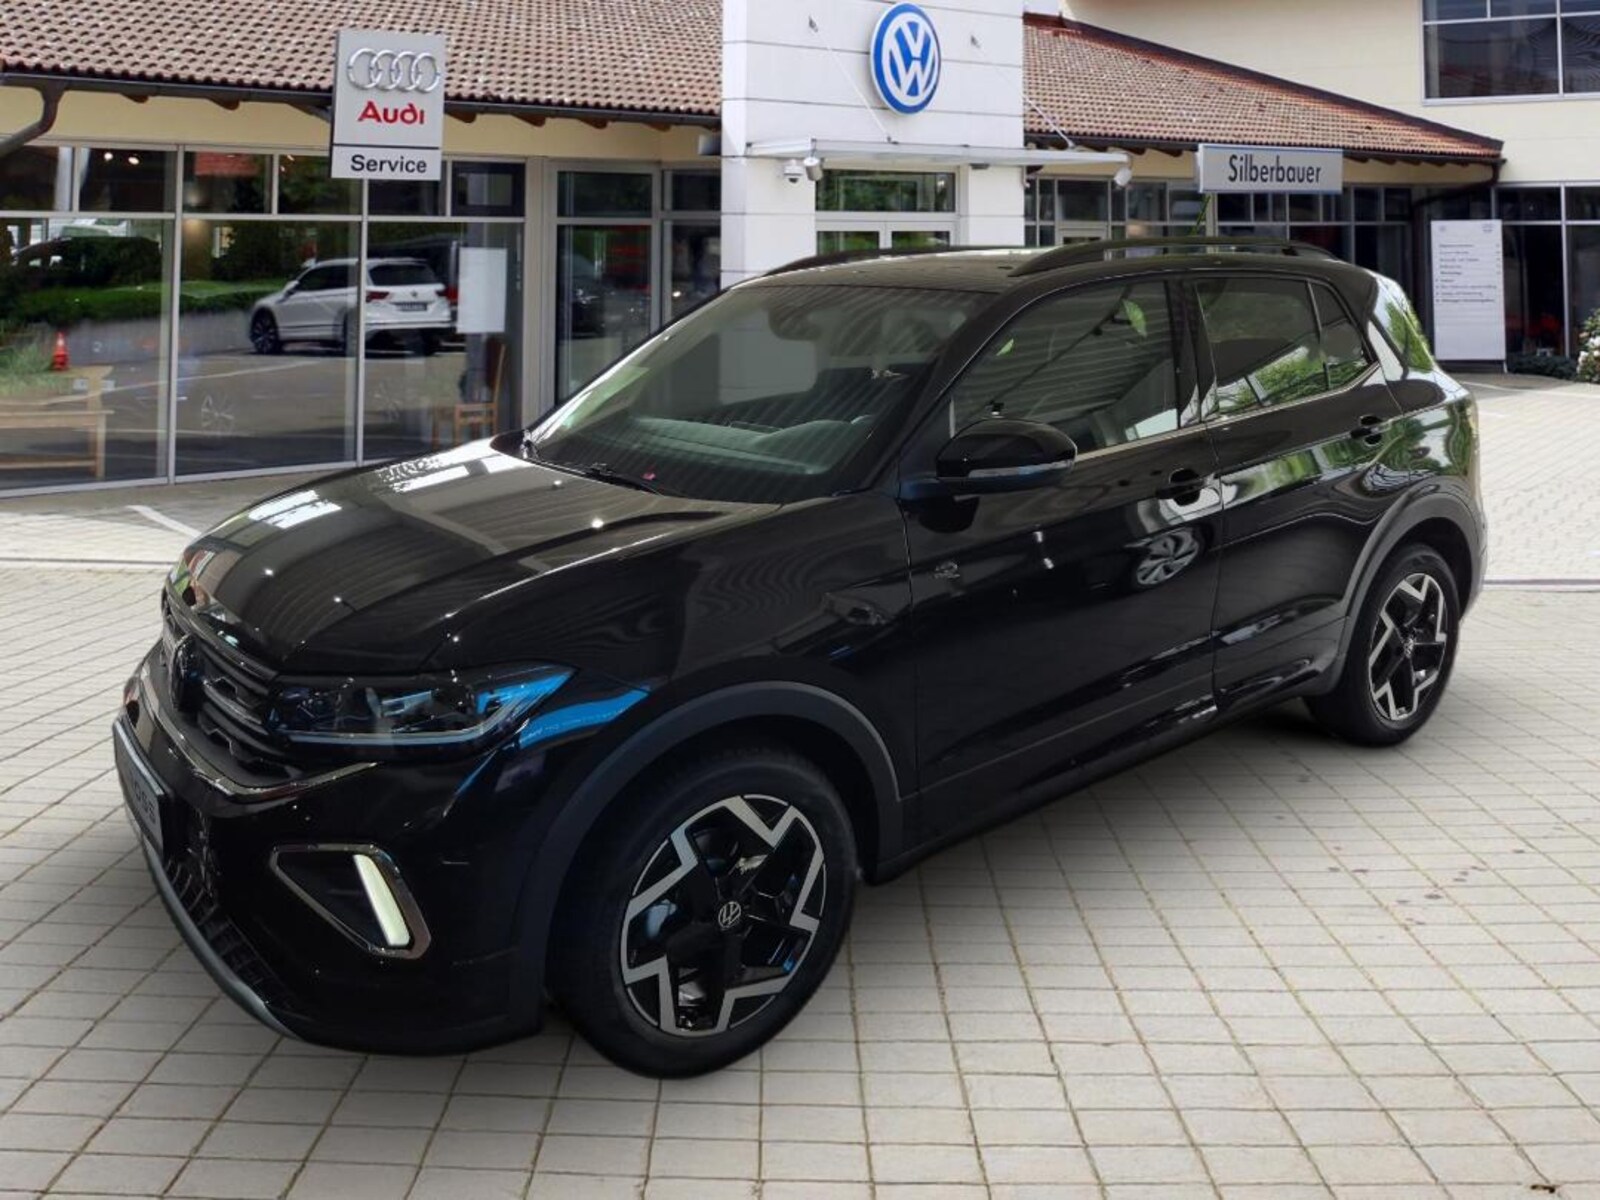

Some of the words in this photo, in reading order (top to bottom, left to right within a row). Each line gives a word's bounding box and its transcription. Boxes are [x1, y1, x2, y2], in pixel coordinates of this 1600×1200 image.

[357, 100, 425, 125] Audi
[350, 154, 428, 173] Service
[1227, 153, 1322, 183] Silberbauer
